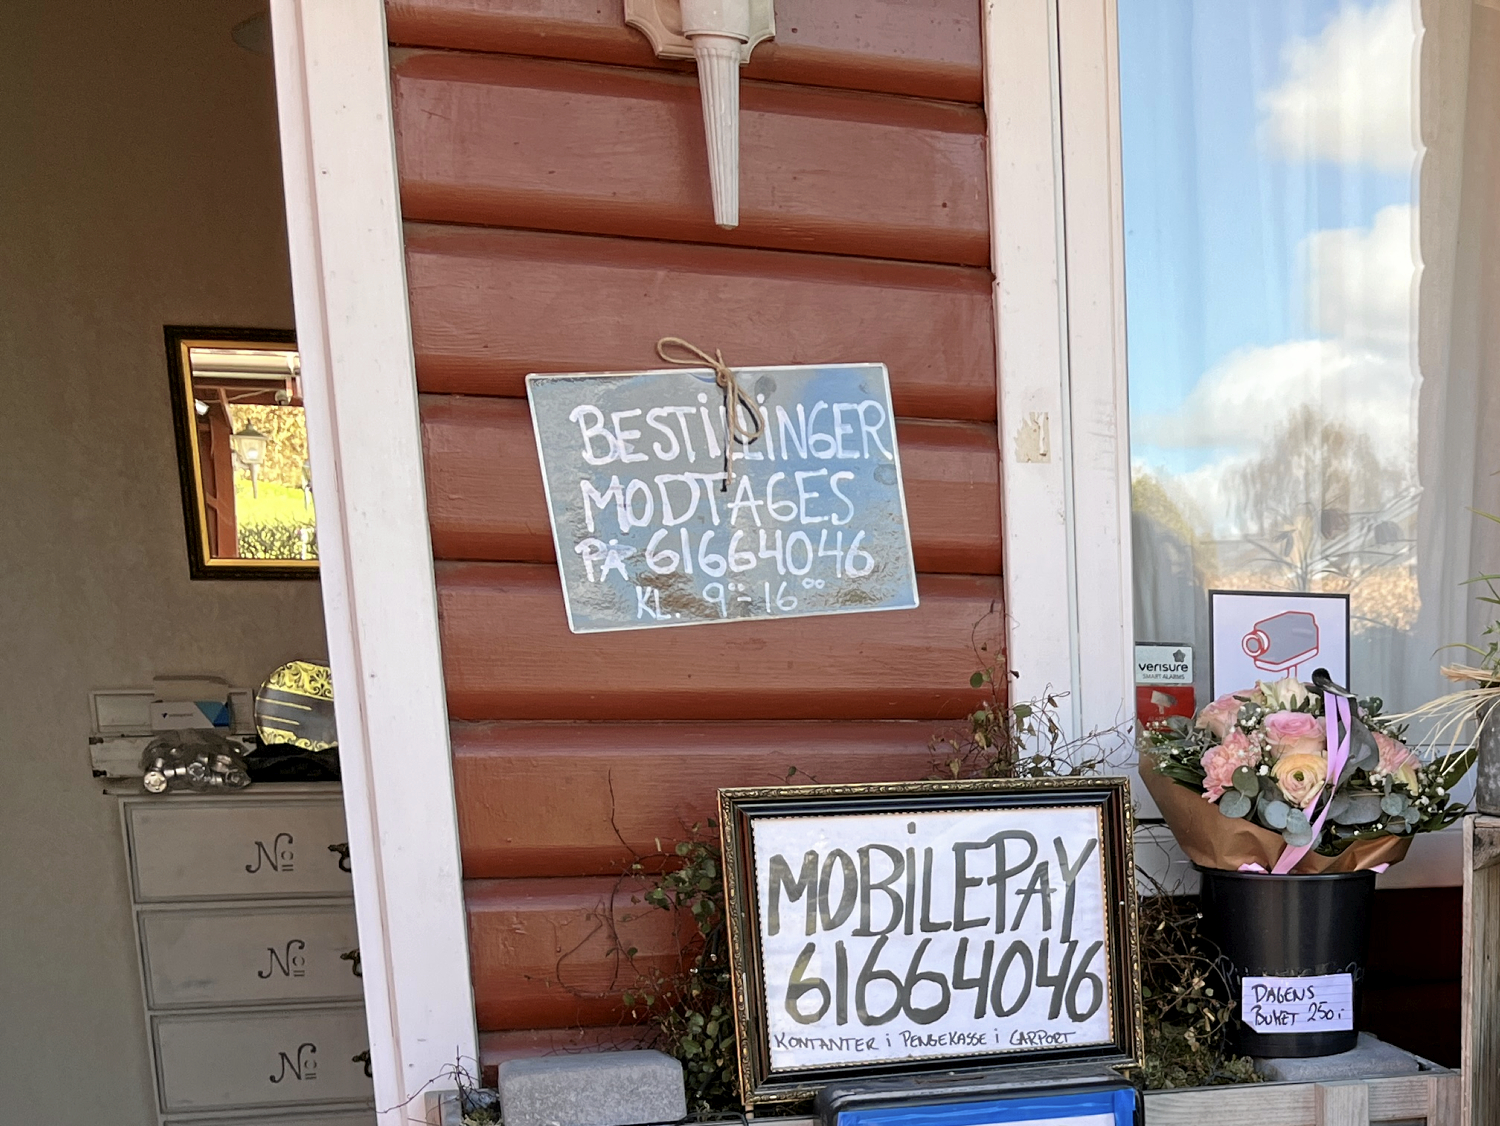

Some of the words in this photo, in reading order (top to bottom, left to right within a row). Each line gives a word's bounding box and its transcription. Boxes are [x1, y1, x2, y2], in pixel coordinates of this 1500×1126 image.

[580, 468, 855, 533] MODTAGES
[574, 539, 637, 583] PÅ
[645, 527, 875, 578] 61664046
[636, 585, 681, 621] KL.
[1138, 662, 1189, 672] verisure
[785, 934, 1103, 1026] 61664046
[1251, 983, 1315, 1003] DAGENS
[1250, 1004, 1300, 1026] BUKET
[773, 1032, 879, 1052] KONTANTER
[899, 1030, 987, 1048] PENGEKASSE
